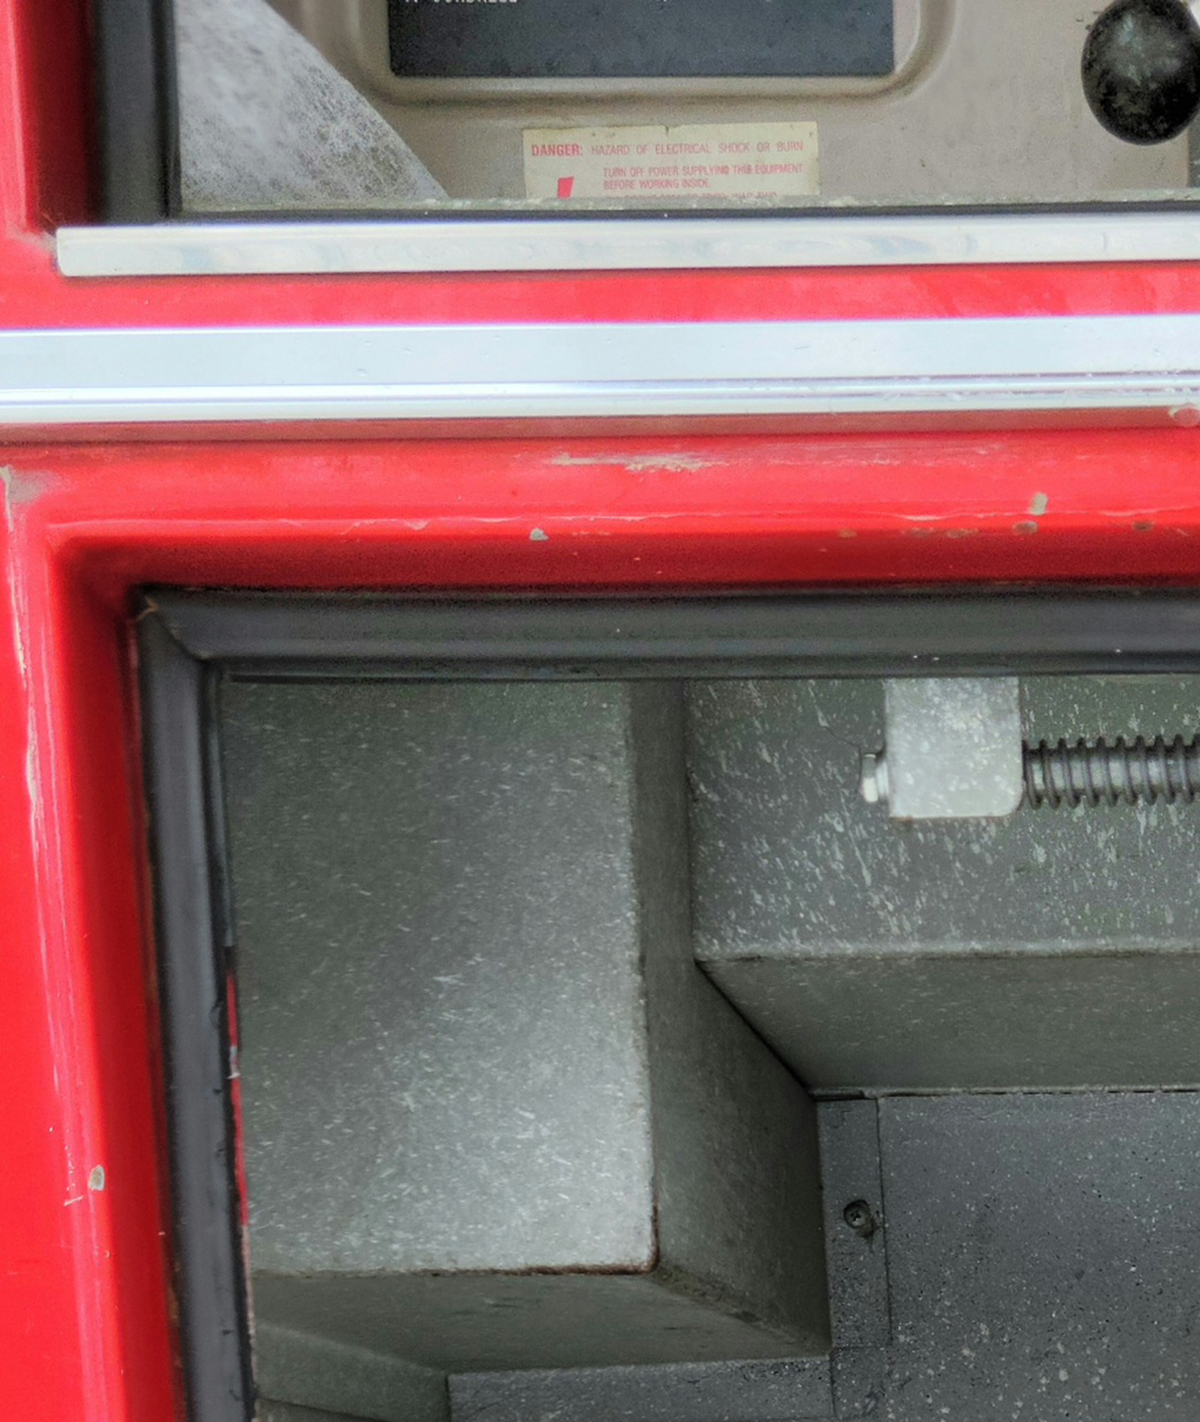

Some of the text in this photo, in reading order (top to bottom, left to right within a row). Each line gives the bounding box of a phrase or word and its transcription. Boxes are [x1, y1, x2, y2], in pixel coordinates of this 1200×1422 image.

[531, 141, 804, 156] DANGER: HAZARD OF ELECTRICAL SHOCK OR BURN
[603, 163, 803, 178] TURN OFF POWER SUPPLYING THIS EQUIPMENT
[603, 180, 636, 190] BEFORE
[639, 179, 679, 189] WORKING
